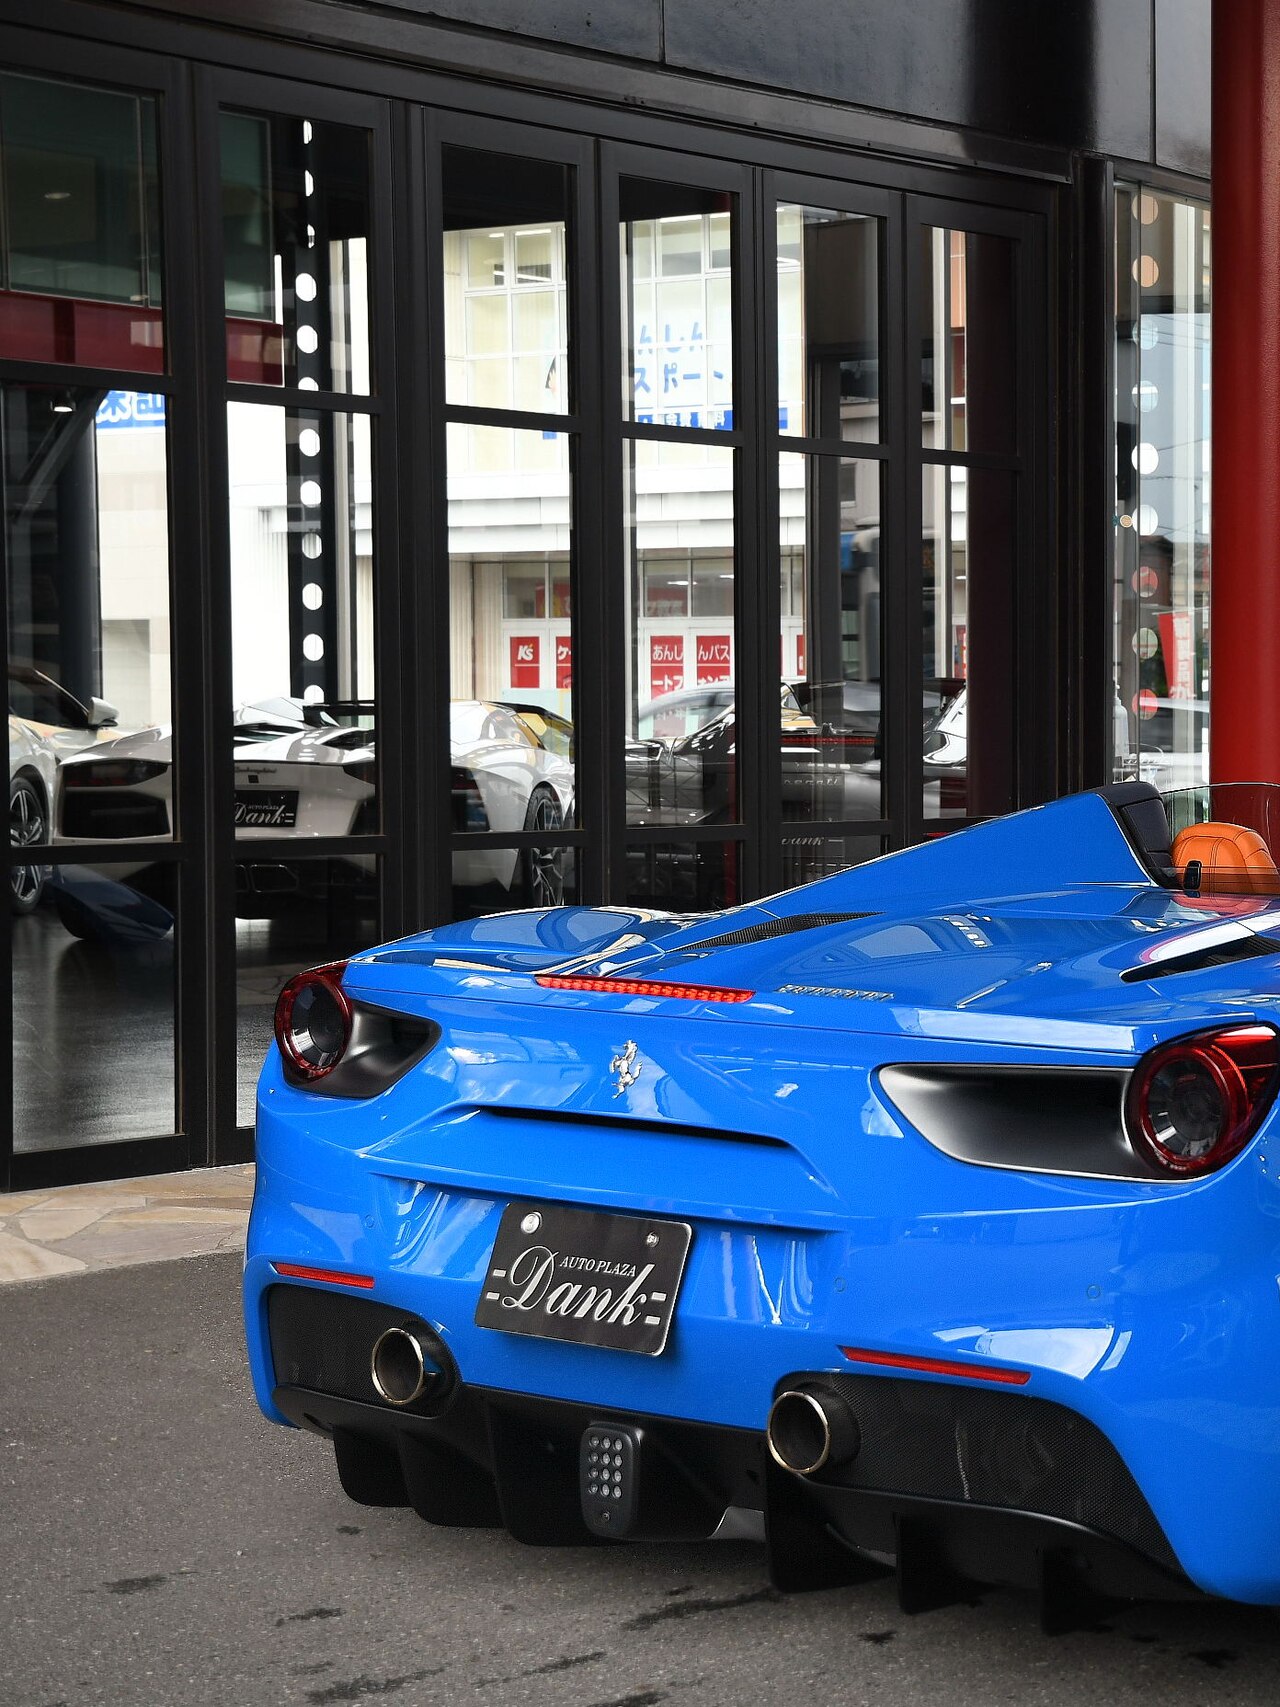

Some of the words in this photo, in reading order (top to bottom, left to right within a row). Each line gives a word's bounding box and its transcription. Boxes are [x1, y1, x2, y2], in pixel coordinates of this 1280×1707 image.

[557, 645, 571, 661] ケ
[559, 1255, 596, 1272] AUTO
[596, 1260, 637, 1278] PLAZA
[501, 1245, 655, 1326] Dank
